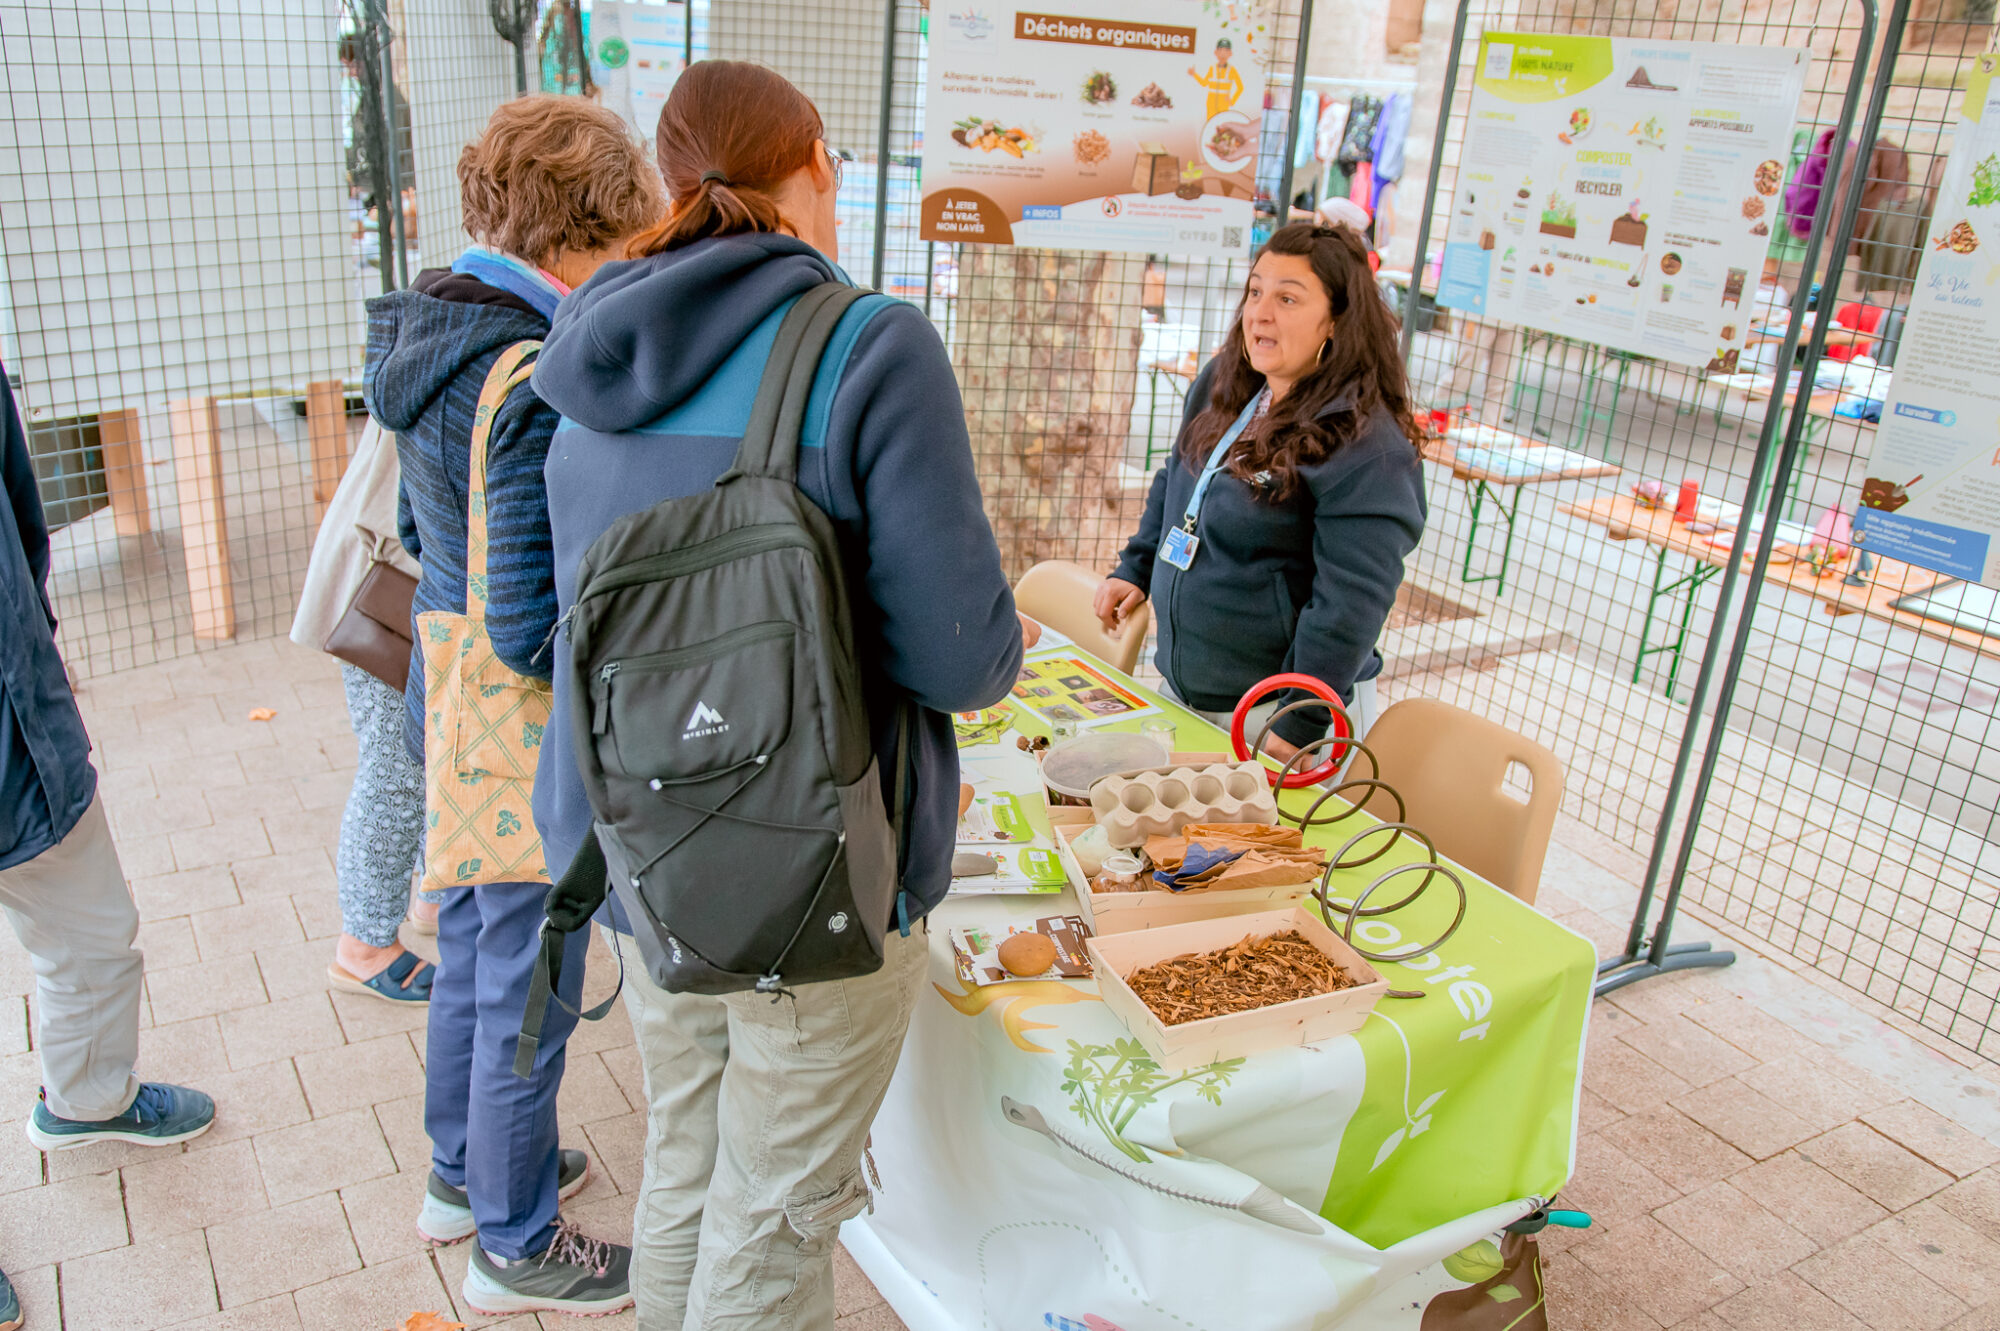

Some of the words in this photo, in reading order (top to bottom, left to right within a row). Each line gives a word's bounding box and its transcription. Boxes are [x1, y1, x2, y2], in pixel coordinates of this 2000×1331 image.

[1024, 17, 1092, 40] Déchets
[1096, 28, 1190, 48] organiques
[1541, 60, 1575, 72] NATURE
[1719, 120, 1754, 133] POSSIBLES
[1576, 150, 1632, 166] COMPOSTER
[1575, 180, 1622, 196] RECYCLER
[955, 201, 977, 210] JETER
[942, 211, 954, 220] EN
[955, 213, 980, 222] VRAC
[1031, 208, 1059, 219] INFOS
[936, 222, 957, 232] NON
[959, 222, 984, 233] LAVÉS
